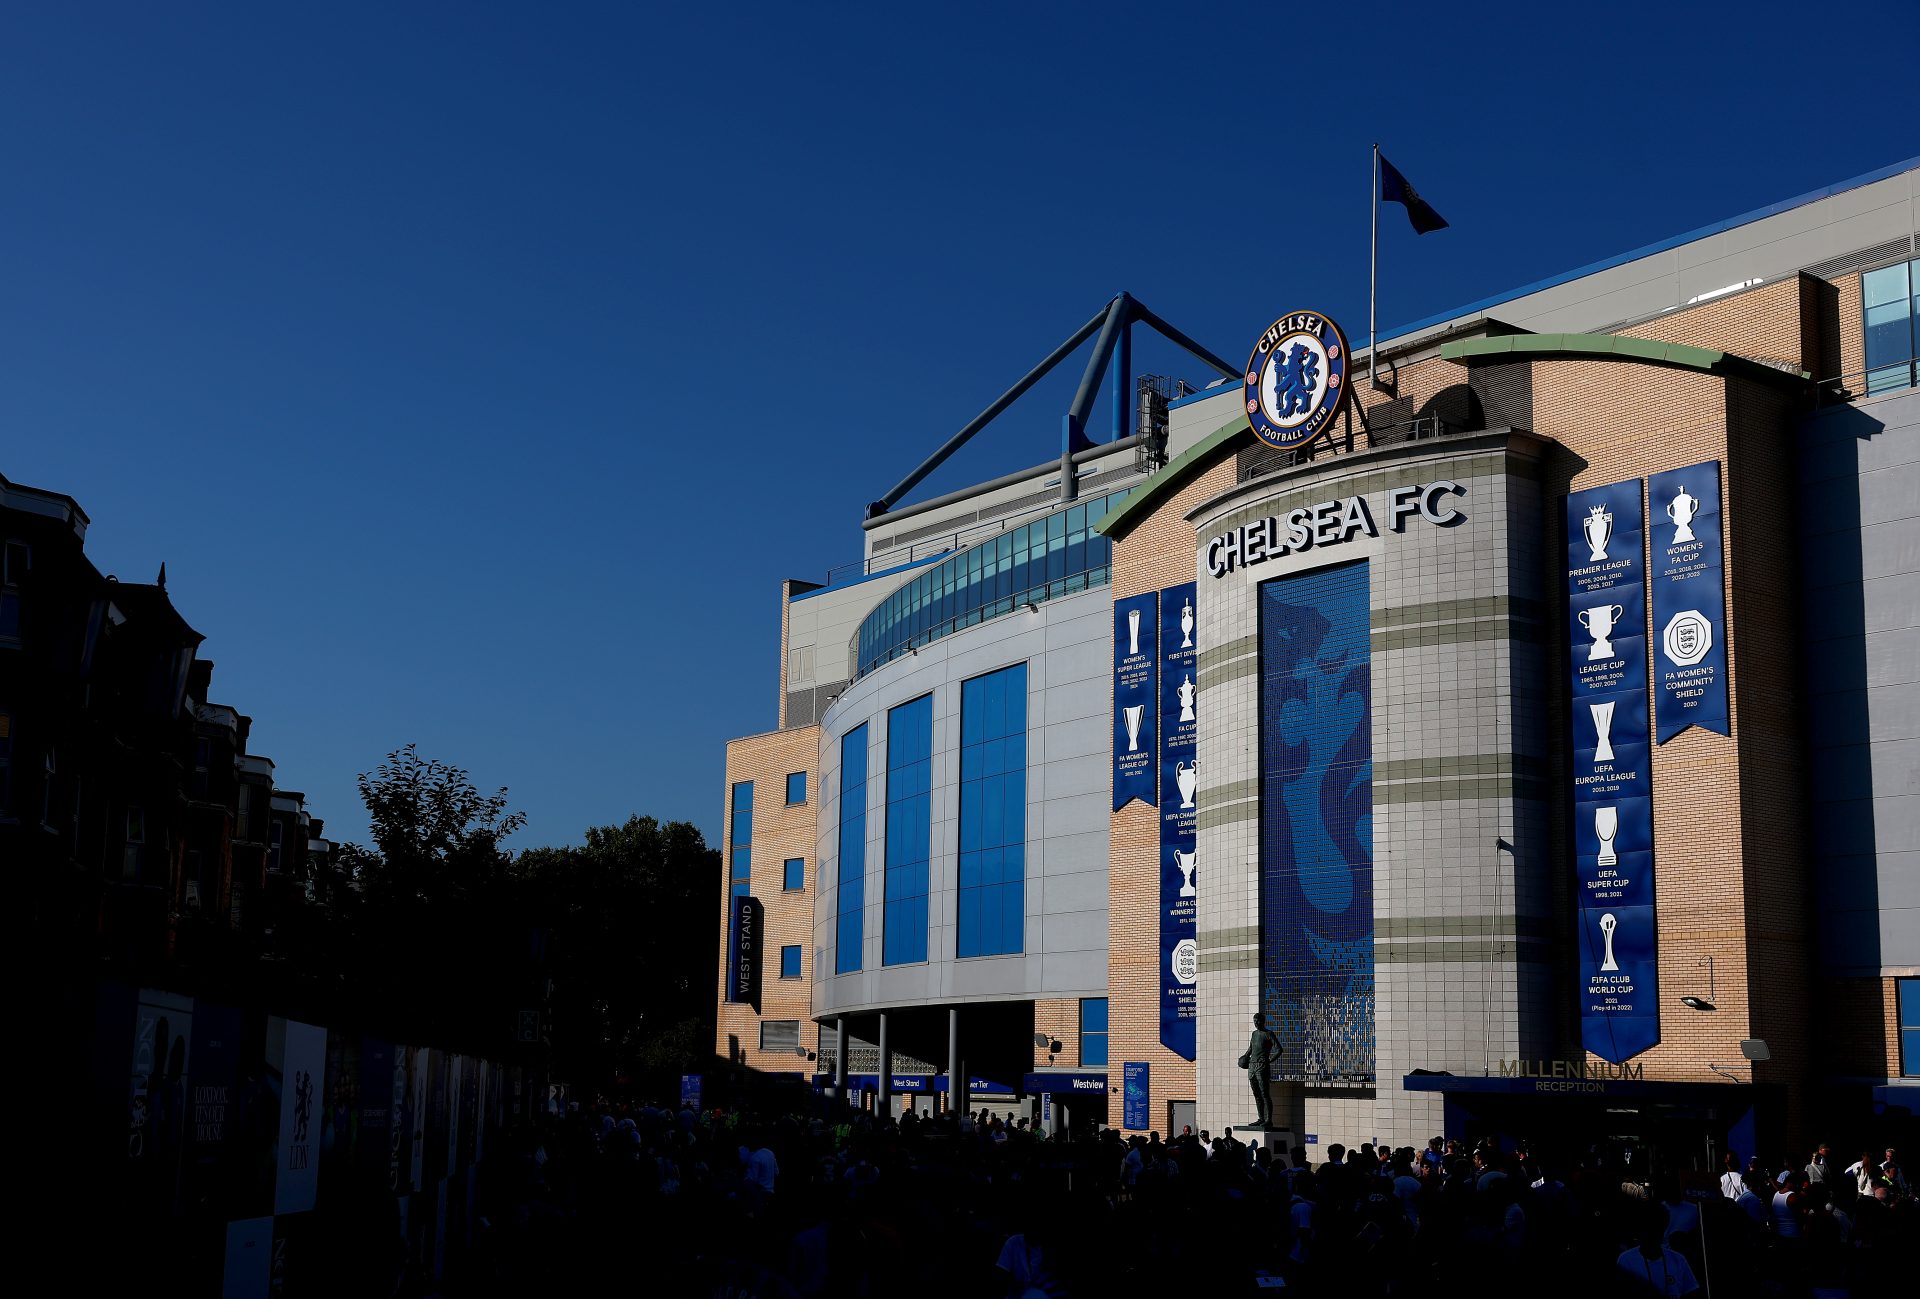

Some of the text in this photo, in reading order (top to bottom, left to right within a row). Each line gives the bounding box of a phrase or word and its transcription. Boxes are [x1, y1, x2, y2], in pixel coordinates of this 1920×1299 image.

[1258, 314, 1324, 355] CHELSEA
[1259, 405, 1328, 443] FOOTBALL CLUB
[1206, 480, 1464, 578] CHELSEA FC
[1666, 542, 1704, 556] WOMEN'S
[1672, 552, 1700, 565] FA CUP
[1568, 559, 1632, 578] PREMIER LEAGUE
[1123, 654, 1146, 664] WOMEN'S
[1168, 652, 1182, 660] FIRST
[1117, 661, 1152, 674] SUPER LEAGUE
[1579, 660, 1625, 674] LEAGUE CUP
[1666, 666, 1714, 680] FA WOMEN'S
[1666, 676, 1714, 690] COMMUNITY
[1676, 688, 1704, 699] SHIELD
[1126, 752, 1148, 760] WOMEN'S
[1119, 761, 1138, 770] LEAGUE
[1594, 764, 1614, 773] UEFA
[1575, 772, 1636, 785] EUROPA LEAGUE
[1598, 870, 1618, 878] UEFA
[1587, 879, 1630, 888] SUPER CUP
[740, 905, 752, 993] WEST STAND
[1588, 986, 1616, 994] WORLD
[1499, 1058, 1644, 1080] MILLENNIUM
[978, 1080, 989, 1088] Tier
[1072, 1079, 1104, 1089] Westview
[1536, 1081, 1605, 1092] RECEPTION
